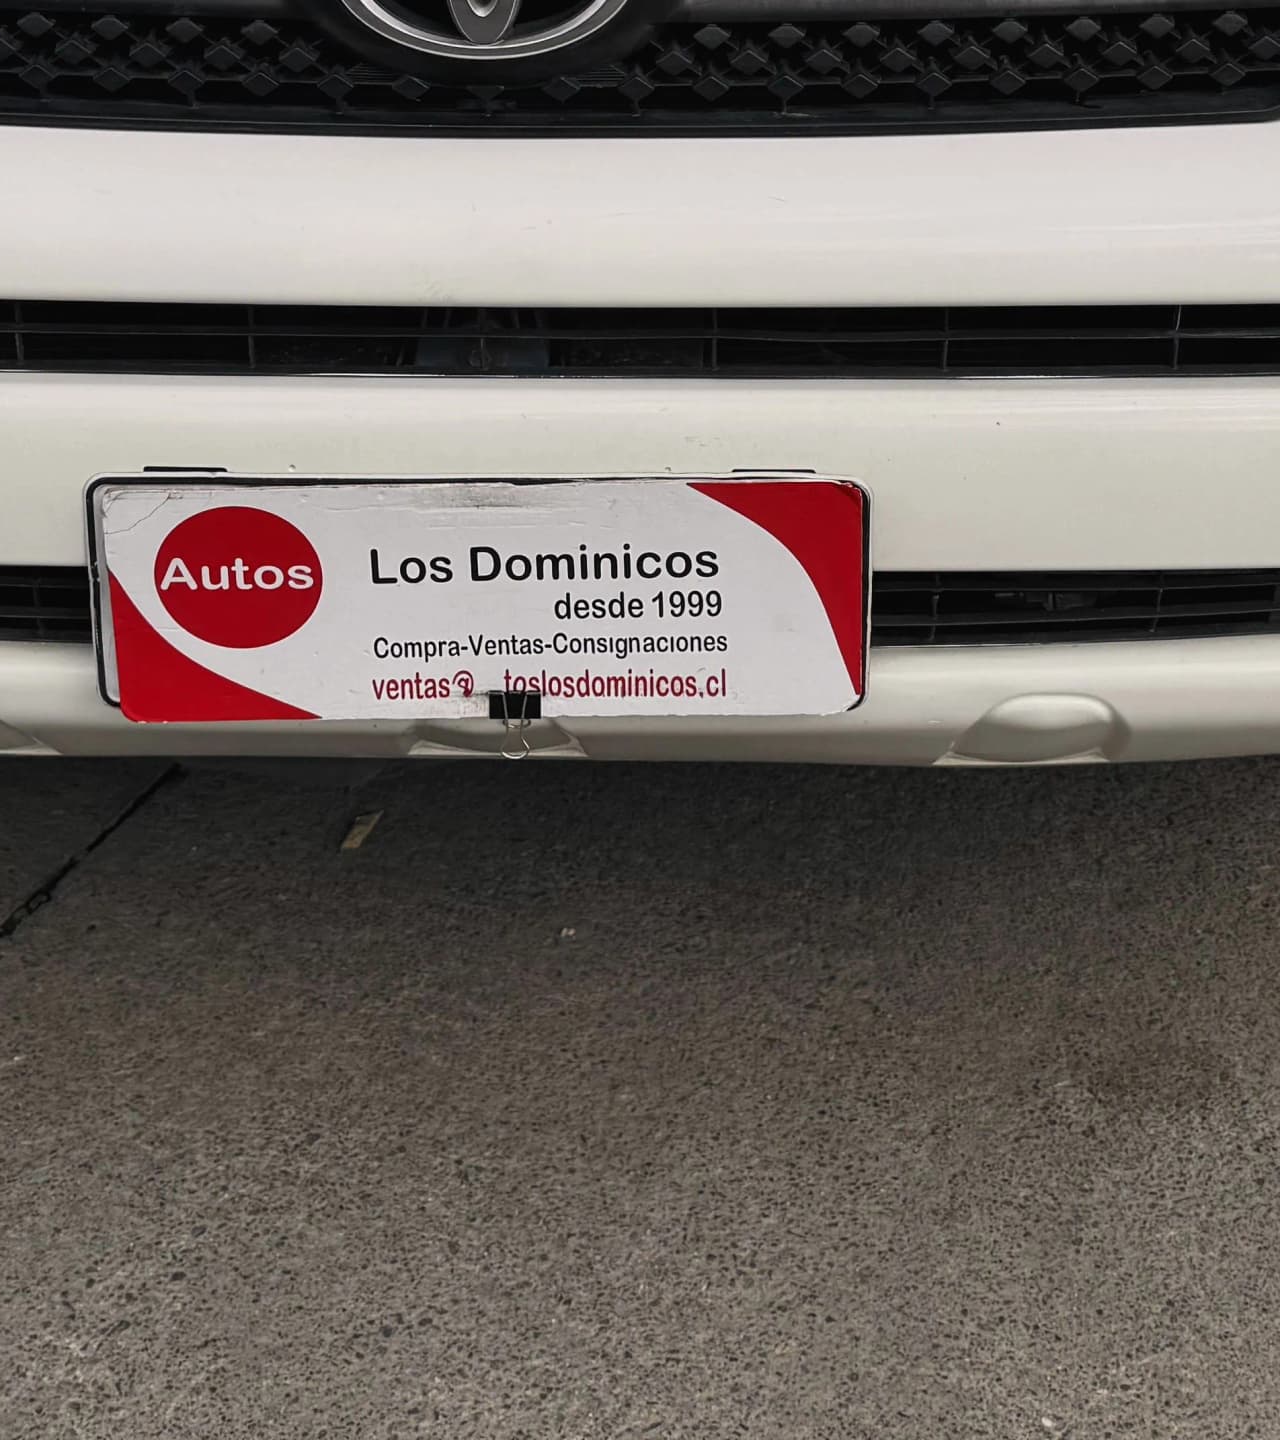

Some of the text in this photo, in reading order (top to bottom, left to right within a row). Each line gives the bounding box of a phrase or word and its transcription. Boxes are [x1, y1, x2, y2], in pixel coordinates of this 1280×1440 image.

[160, 556, 316, 592] Autos
[370, 543, 719, 585] Los Dominicos
[554, 590, 722, 620] desde 1999
[373, 632, 728, 663] Compra-Ventas-Consignaciones
[372, 668, 726, 700] ventas@toslosdominicos.cl
